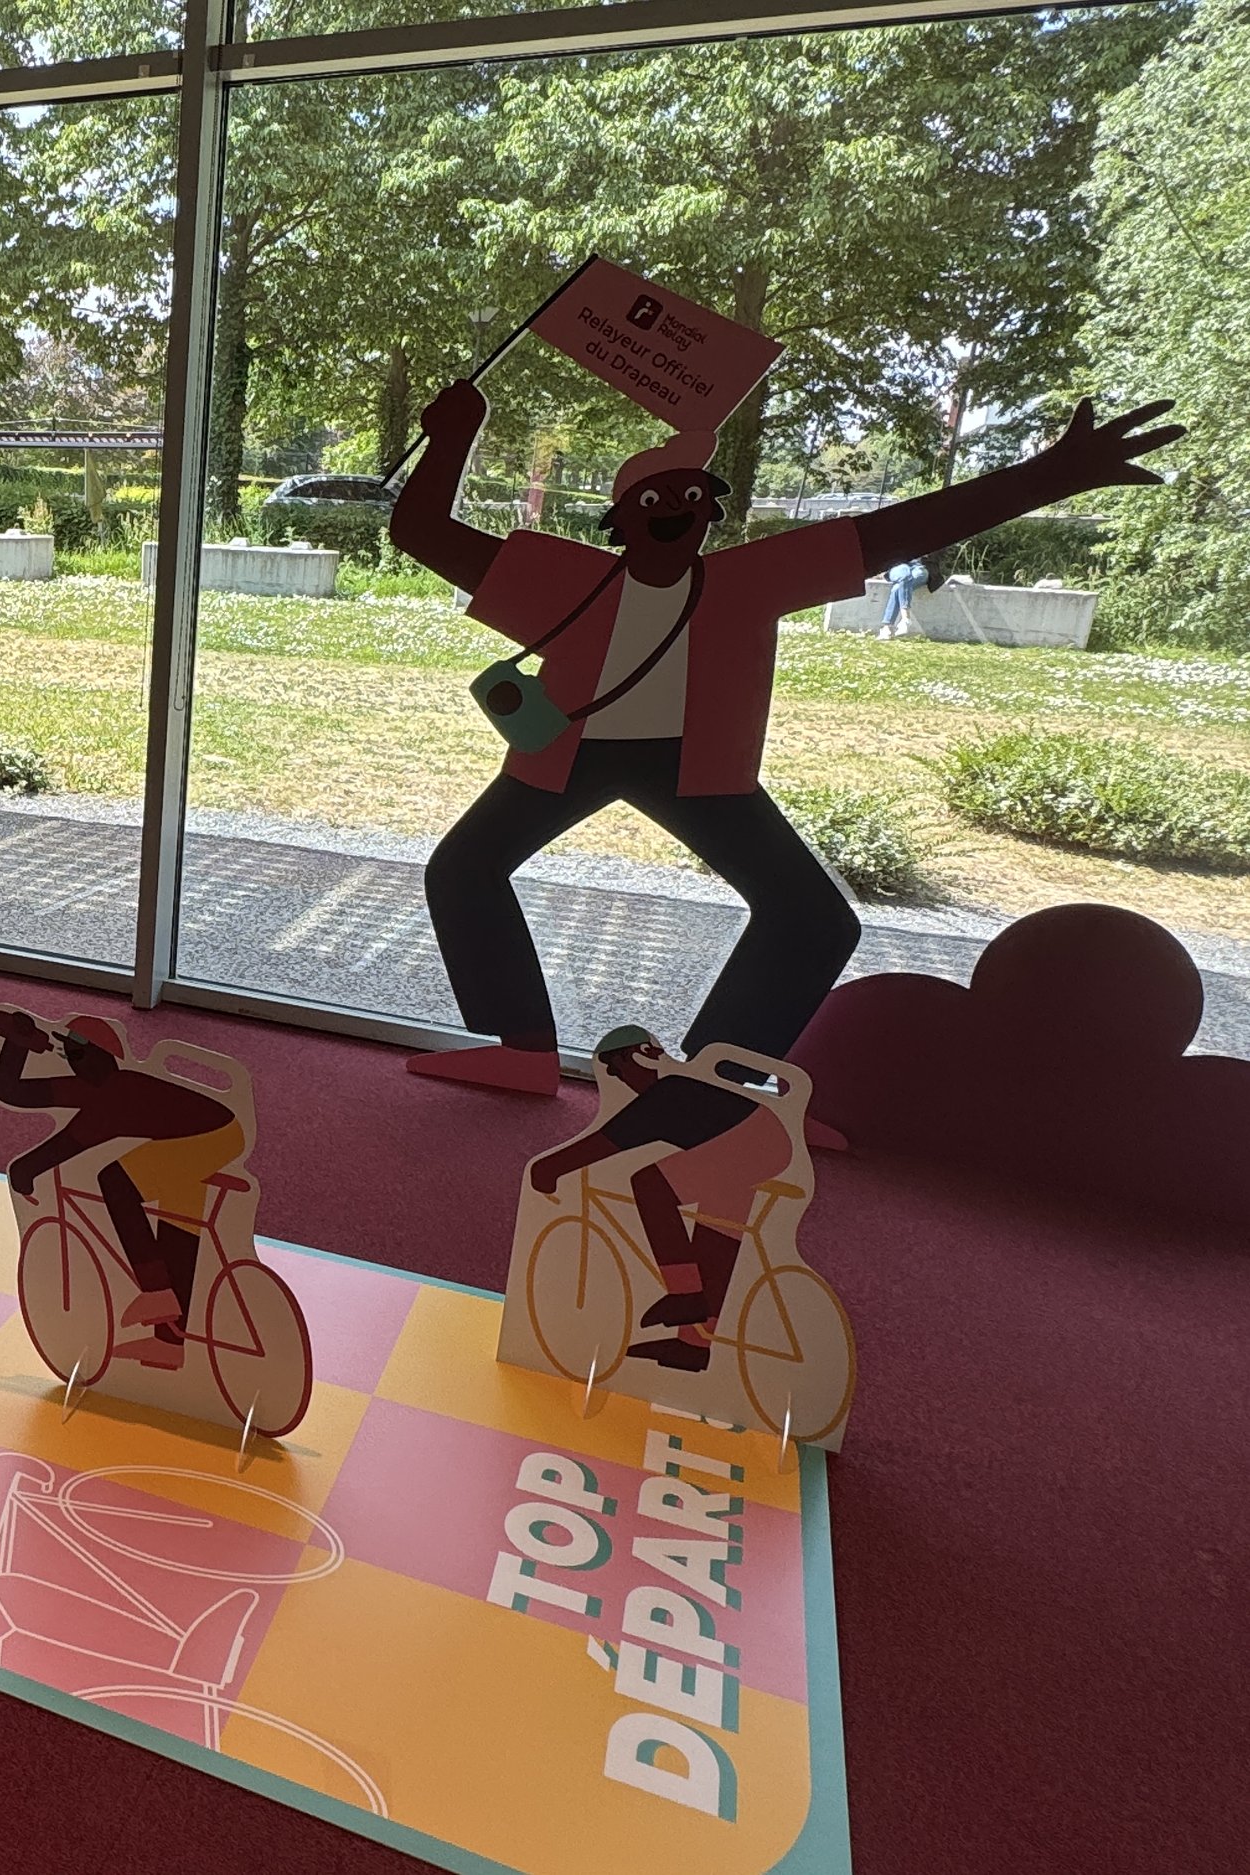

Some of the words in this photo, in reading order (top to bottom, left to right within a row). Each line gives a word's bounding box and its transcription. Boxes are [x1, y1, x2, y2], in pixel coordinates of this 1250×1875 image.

[577, 306, 649, 359] Relayeur
[652, 352, 715, 397] Officiel
[657, 323, 693, 351] Relay
[662, 313, 709, 344] Mondial
[585, 340, 607, 362] du
[610, 354, 681, 406] Drapeau
[486, 1451, 617, 1618] TOP
